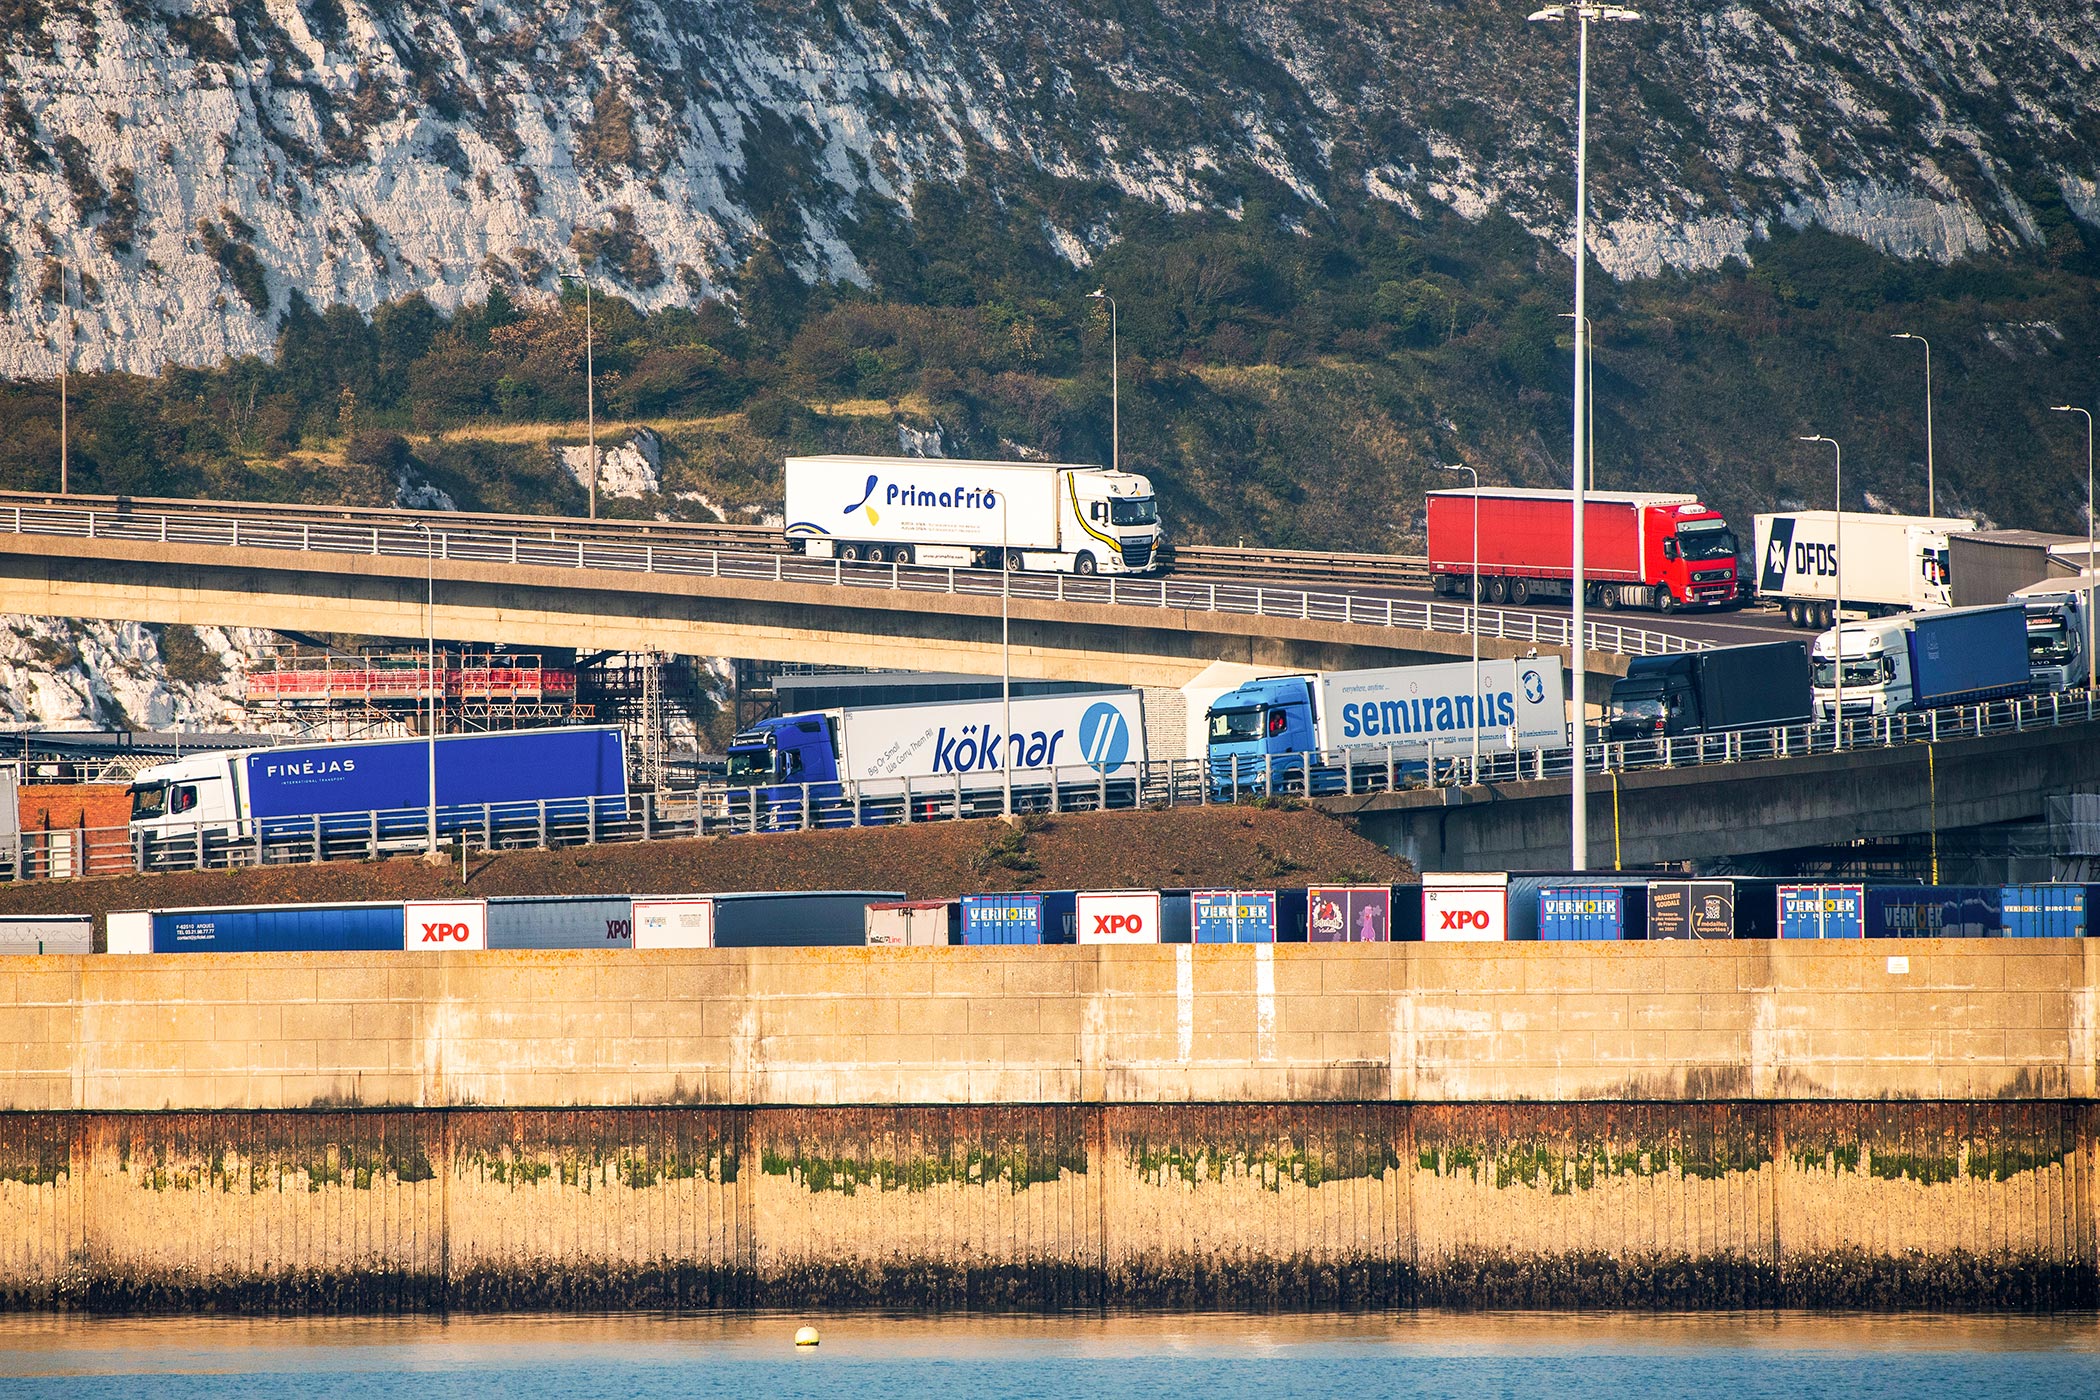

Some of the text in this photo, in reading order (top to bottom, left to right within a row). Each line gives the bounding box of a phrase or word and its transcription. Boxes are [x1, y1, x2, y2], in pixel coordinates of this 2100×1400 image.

[1795, 542, 1838, 577] DFDS
[1342, 691, 1515, 738] semiramis
[932, 724, 1064, 773] köknar
[867, 741, 901, 777] Big Or Small
[1545, 900, 1616, 914] VERHOEK
[1653, 892, 1681, 902] BRASSERIE
[1656, 899, 1680, 909] GOUDALE
[1786, 899, 1855, 913] VERHOEK
[1200, 905, 1268, 919] VERHOEK
[1440, 909, 1490, 930] XPO
[1695, 912, 1705, 927] 7
[1884, 904, 1943, 929] VERHOEK
[421, 923, 470, 942] XPO
[1093, 914, 1143, 935] XPO
